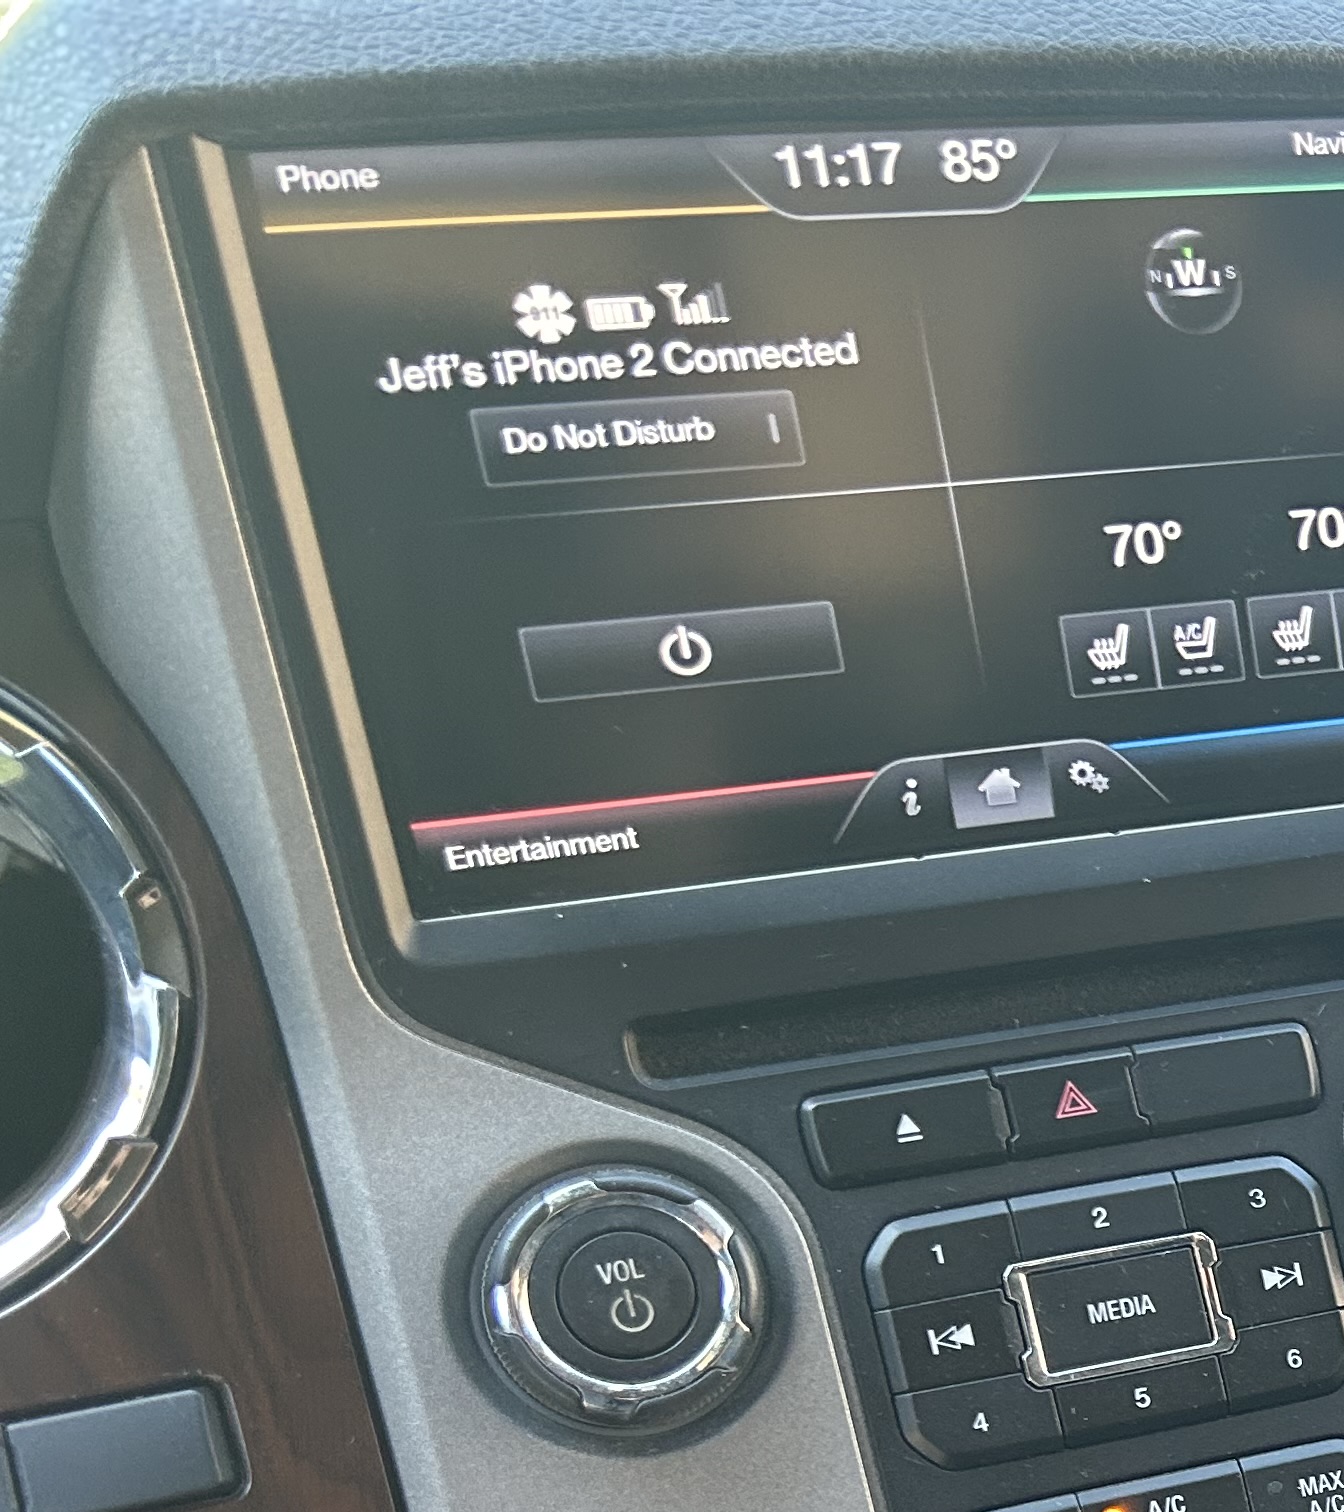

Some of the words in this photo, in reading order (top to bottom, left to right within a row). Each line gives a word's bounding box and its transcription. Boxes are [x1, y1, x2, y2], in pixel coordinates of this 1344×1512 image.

[774, 141, 901, 189] 11:17
[939, 138, 1017, 183] 85°
[277, 163, 381, 194] Phone
[1171, 259, 1206, 287] W
[376, 353, 487, 393] Jeff's
[491, 349, 624, 386] iPhone
[629, 343, 657, 378] 2
[662, 331, 860, 377] Connected
[502, 428, 547, 455] Do
[552, 422, 609, 451] Not
[614, 416, 716, 446] Disturb
[1102, 520, 1182, 567] 70°
[444, 826, 639, 871] Entertainment
[1249, 1188, 1267, 1209] 3
[1091, 1208, 1111, 1229] 2
[929, 1244, 945, 1264] 1
[595, 1259, 645, 1285] VOL
[1086, 1294, 1157, 1324] MEDIA
[1286, 1349, 1303, 1369] 6
[1133, 1387, 1152, 1408] 5
[972, 1412, 990, 1433] 4
